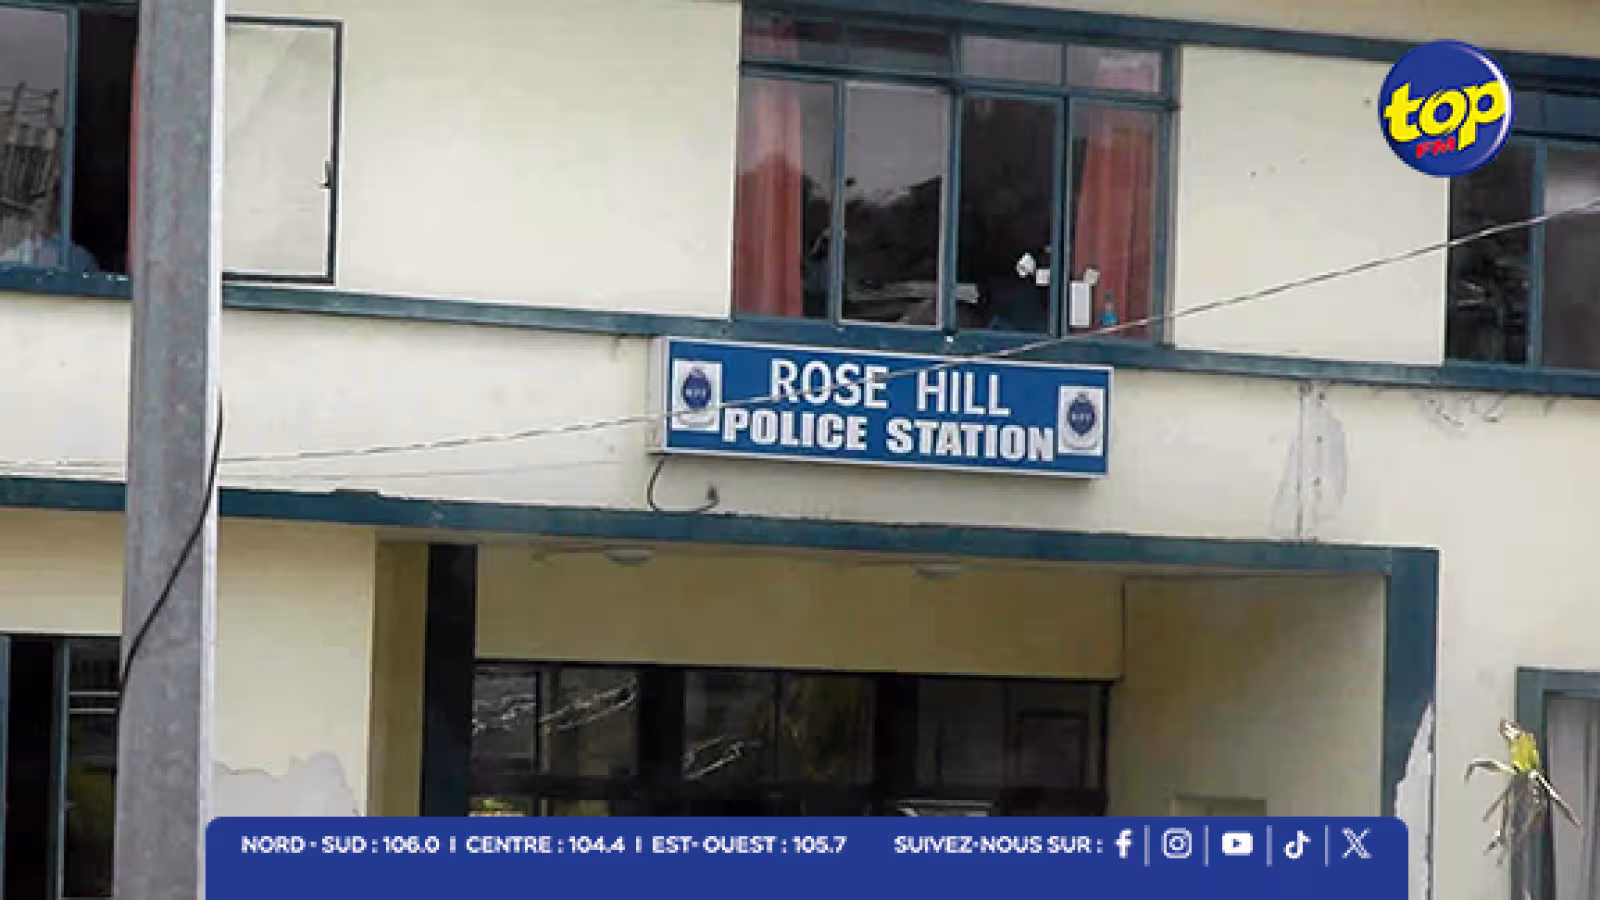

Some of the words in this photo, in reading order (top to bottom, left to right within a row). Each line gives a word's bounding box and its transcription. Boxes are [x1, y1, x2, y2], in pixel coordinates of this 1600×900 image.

[769, 357, 890, 409] ROSE
[916, 368, 1011, 416] HILL
[721, 406, 868, 451] POLICE
[886, 417, 1054, 463] STATION
